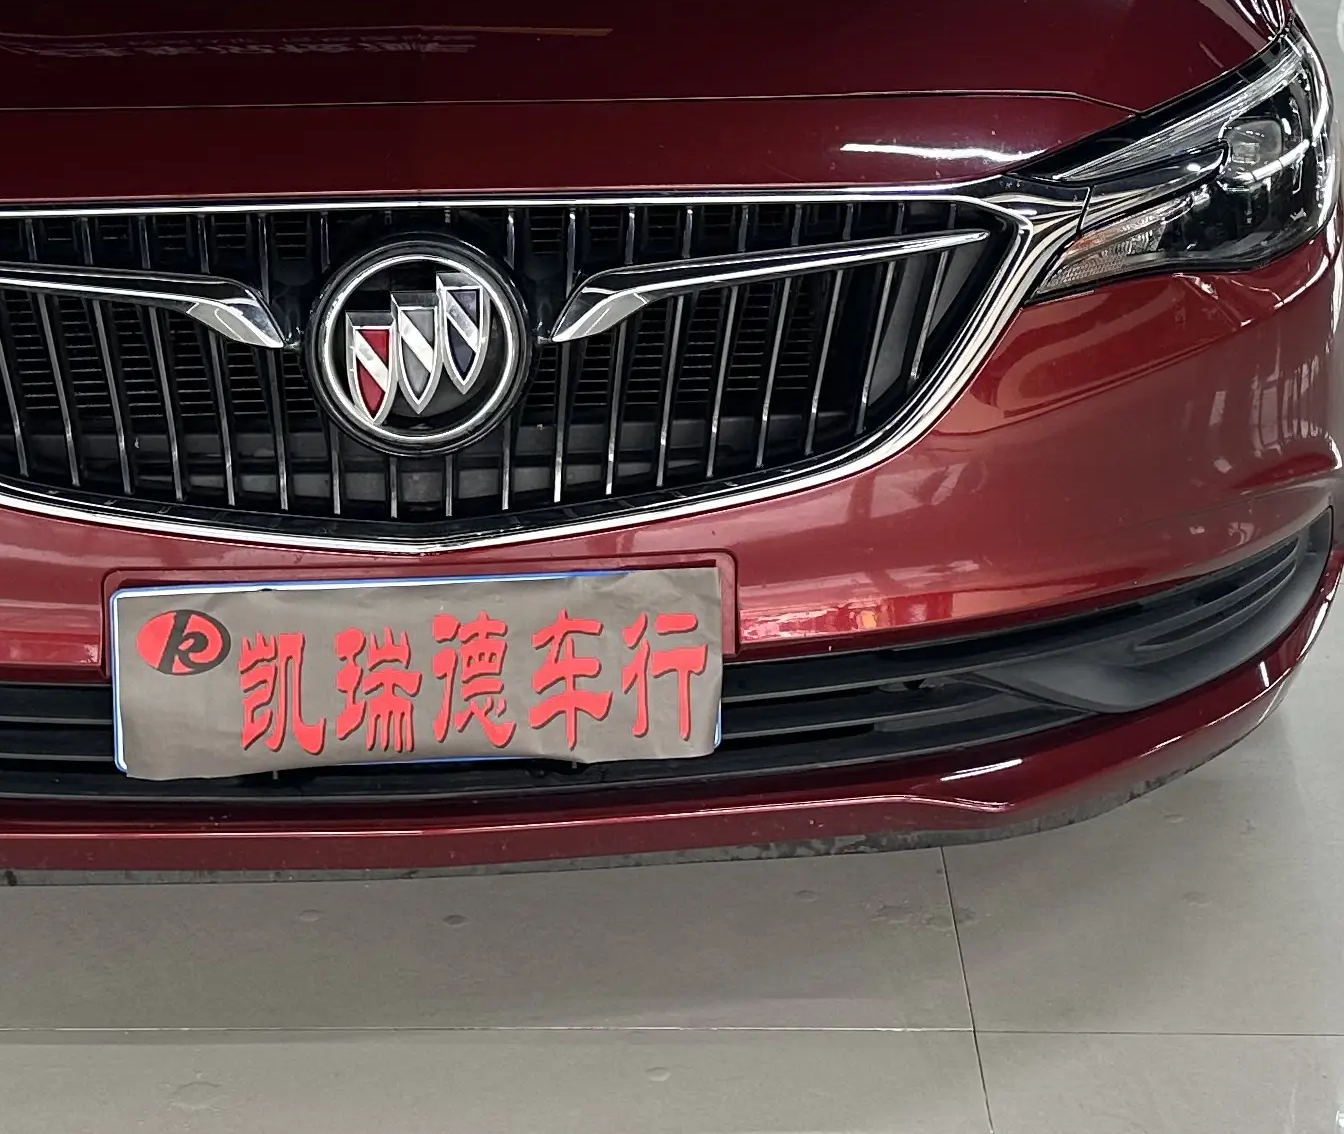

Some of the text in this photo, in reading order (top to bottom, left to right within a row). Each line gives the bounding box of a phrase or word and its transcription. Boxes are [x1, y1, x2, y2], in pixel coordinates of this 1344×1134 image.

[238, 609, 708, 755] 凯瑞德车行
